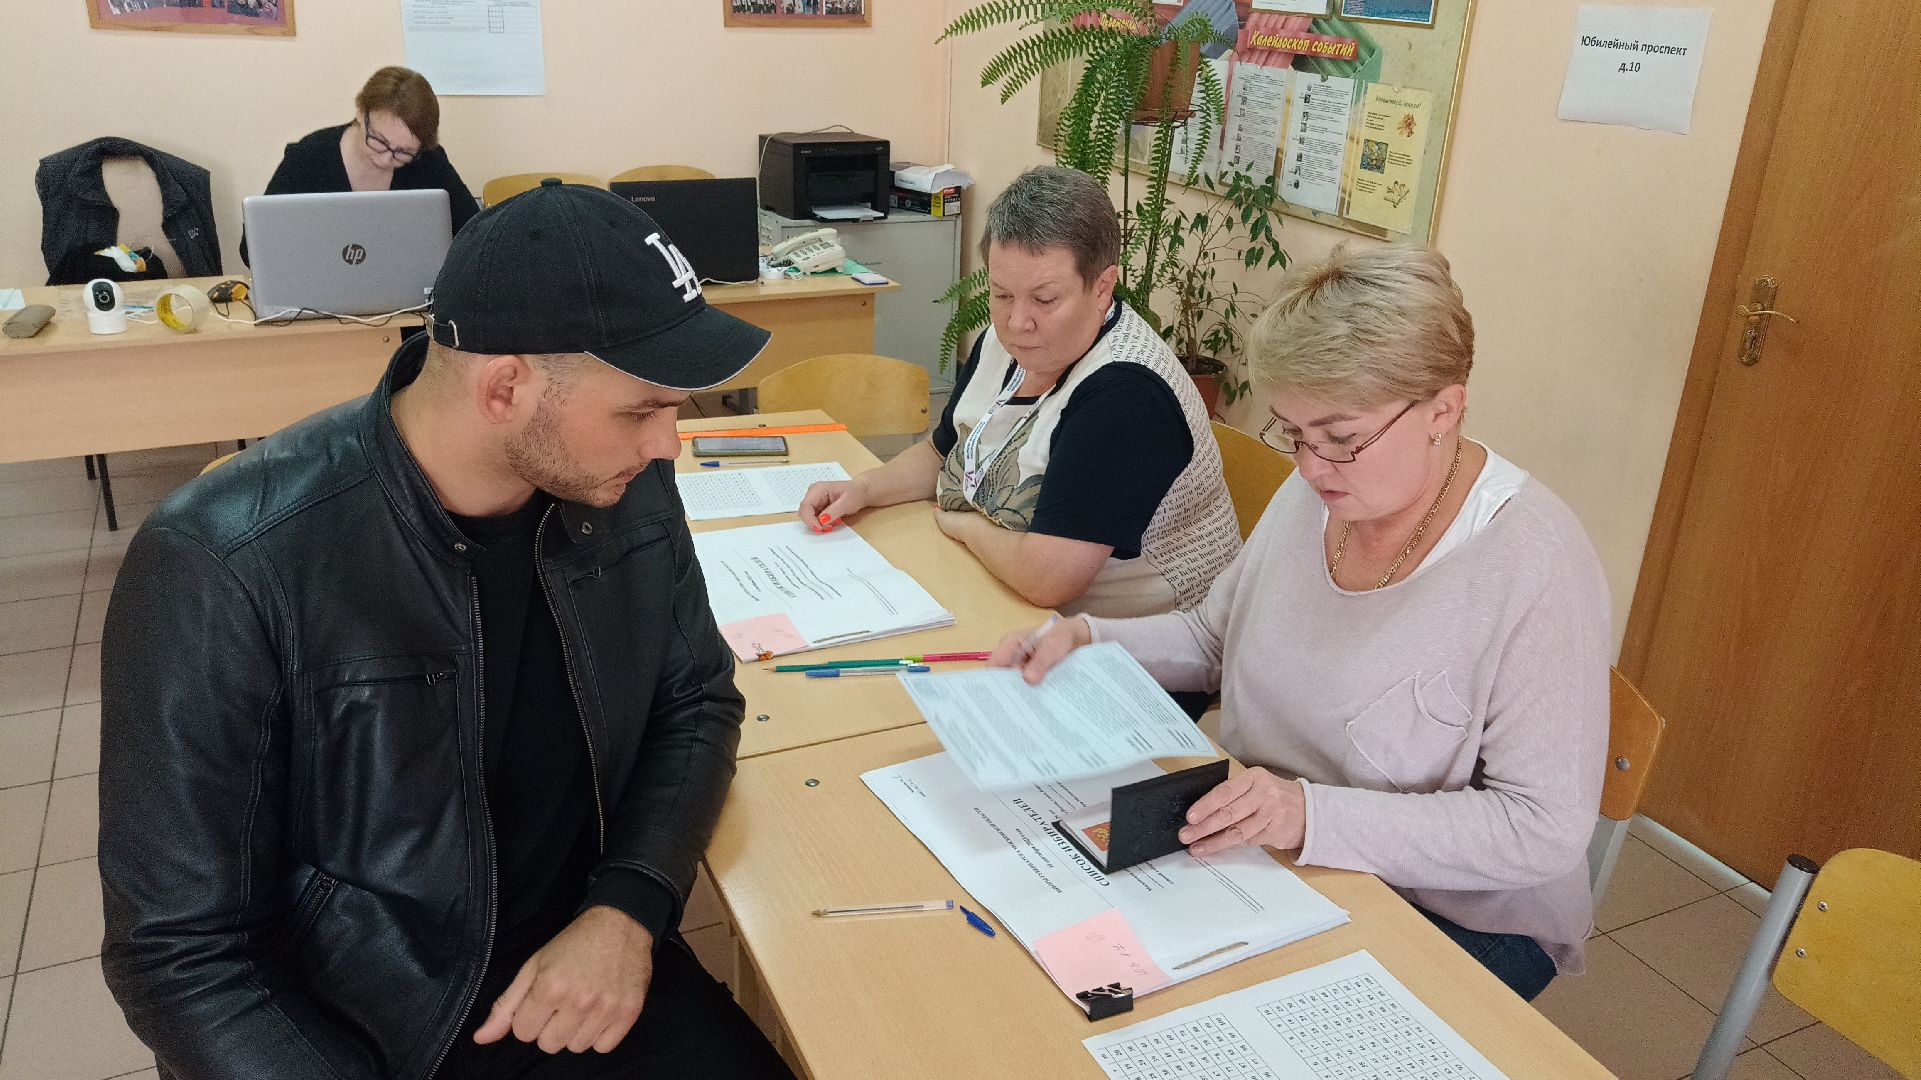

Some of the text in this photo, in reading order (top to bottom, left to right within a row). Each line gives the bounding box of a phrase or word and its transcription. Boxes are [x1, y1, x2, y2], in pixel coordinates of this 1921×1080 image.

[1250, 30, 1355, 56] Калейдоскоп событий
[1581, 36, 1687, 55] Юбилейный проспект
[1618, 62, 1640, 73] д.10
[345, 244, 364, 265] hp
[1013, 798, 1071, 851] ИЗБИРАТЕЛЕЙ
[1070, 851, 1109, 887] СПИСОК
